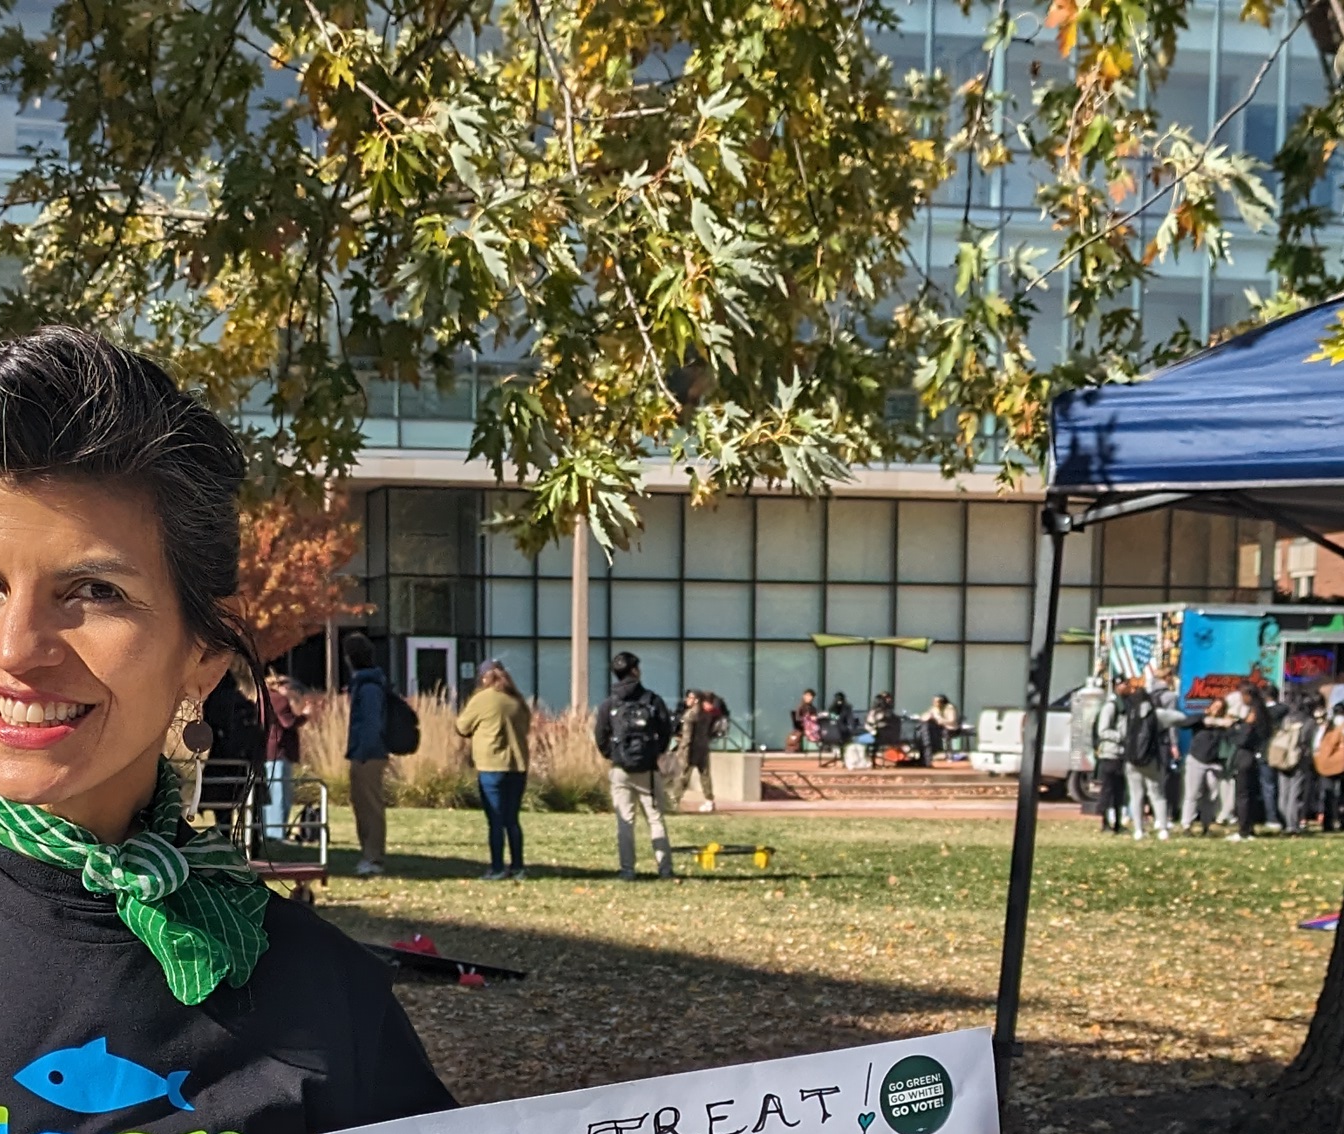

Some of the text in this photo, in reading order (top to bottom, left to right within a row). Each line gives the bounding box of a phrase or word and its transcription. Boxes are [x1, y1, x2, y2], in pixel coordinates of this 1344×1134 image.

[889, 1073, 942, 1092] GO GREEN!
[890, 1085, 943, 1103] GO WHITE!
[892, 1097, 944, 1117] GO VOTE!
